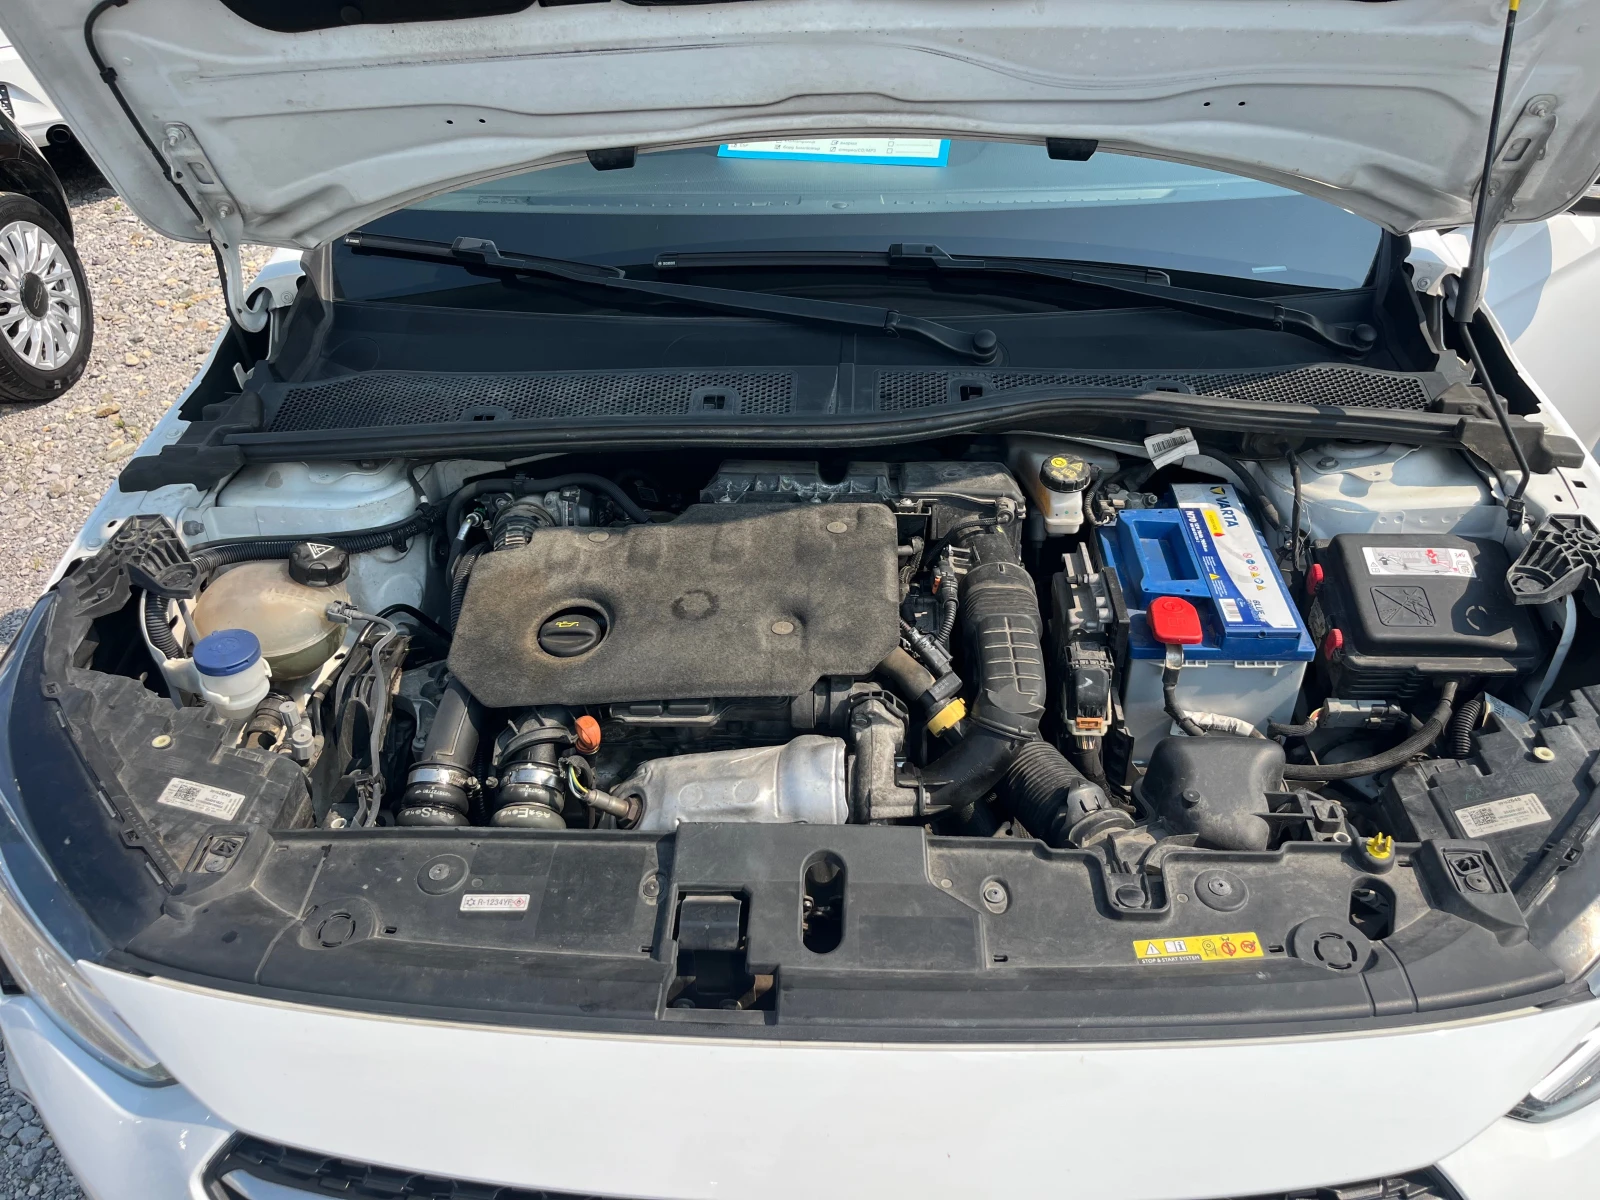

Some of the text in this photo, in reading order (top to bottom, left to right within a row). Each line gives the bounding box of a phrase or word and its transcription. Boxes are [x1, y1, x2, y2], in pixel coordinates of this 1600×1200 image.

[1185, 510, 1198, 523] N70
[1215, 496, 1240, 528] VARTA
[477, 898, 513, 906] R-1234YF
